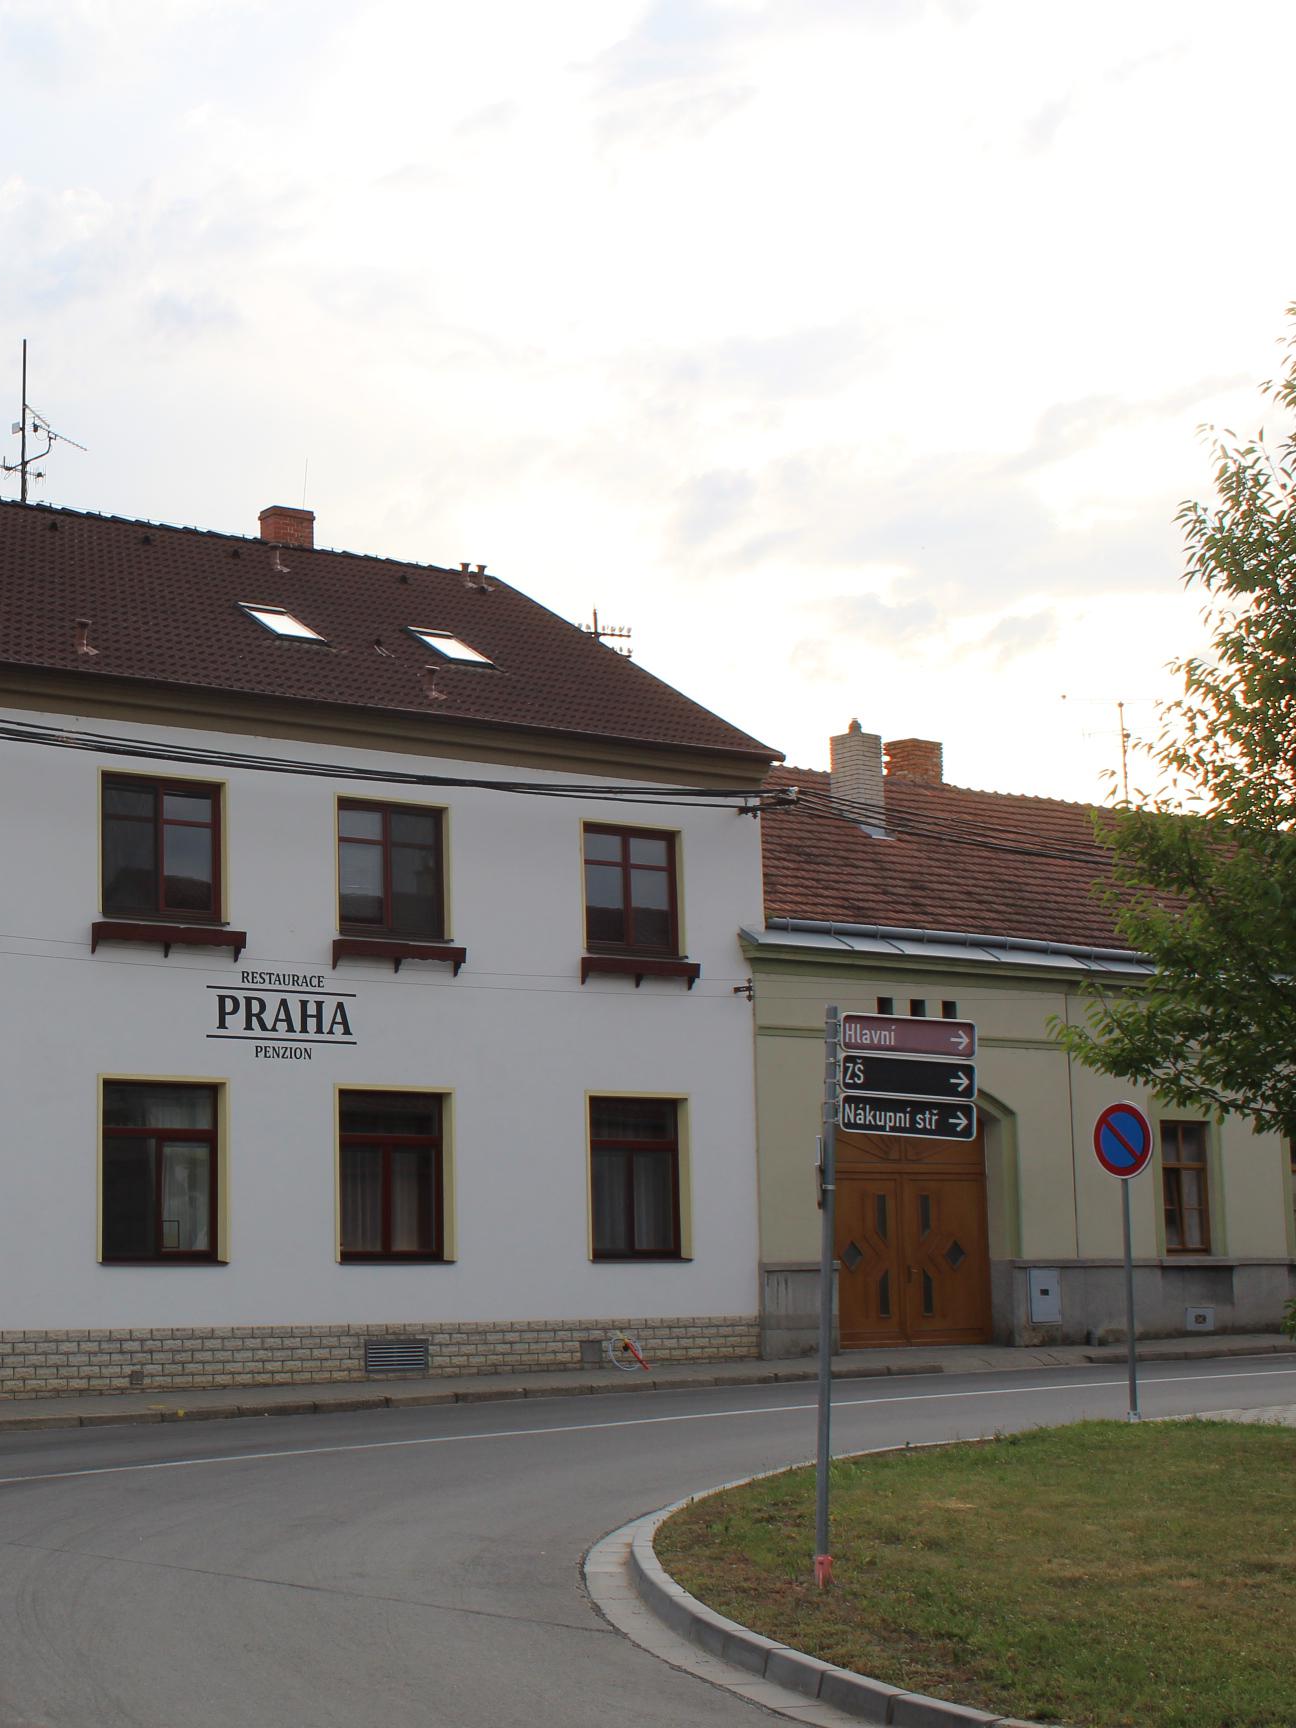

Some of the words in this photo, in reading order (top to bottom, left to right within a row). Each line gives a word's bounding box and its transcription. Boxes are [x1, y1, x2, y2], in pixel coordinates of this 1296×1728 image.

[241, 970, 325, 988] RESTAURACE
[216, 994, 353, 1036] PRAHA
[845, 1022, 896, 1046] Hlavní
[255, 1045, 312, 1060] PENZION
[844, 1058, 864, 1084] ZŠ
[844, 1103, 911, 1131] Nákupní
[915, 1108, 939, 1130] stř
